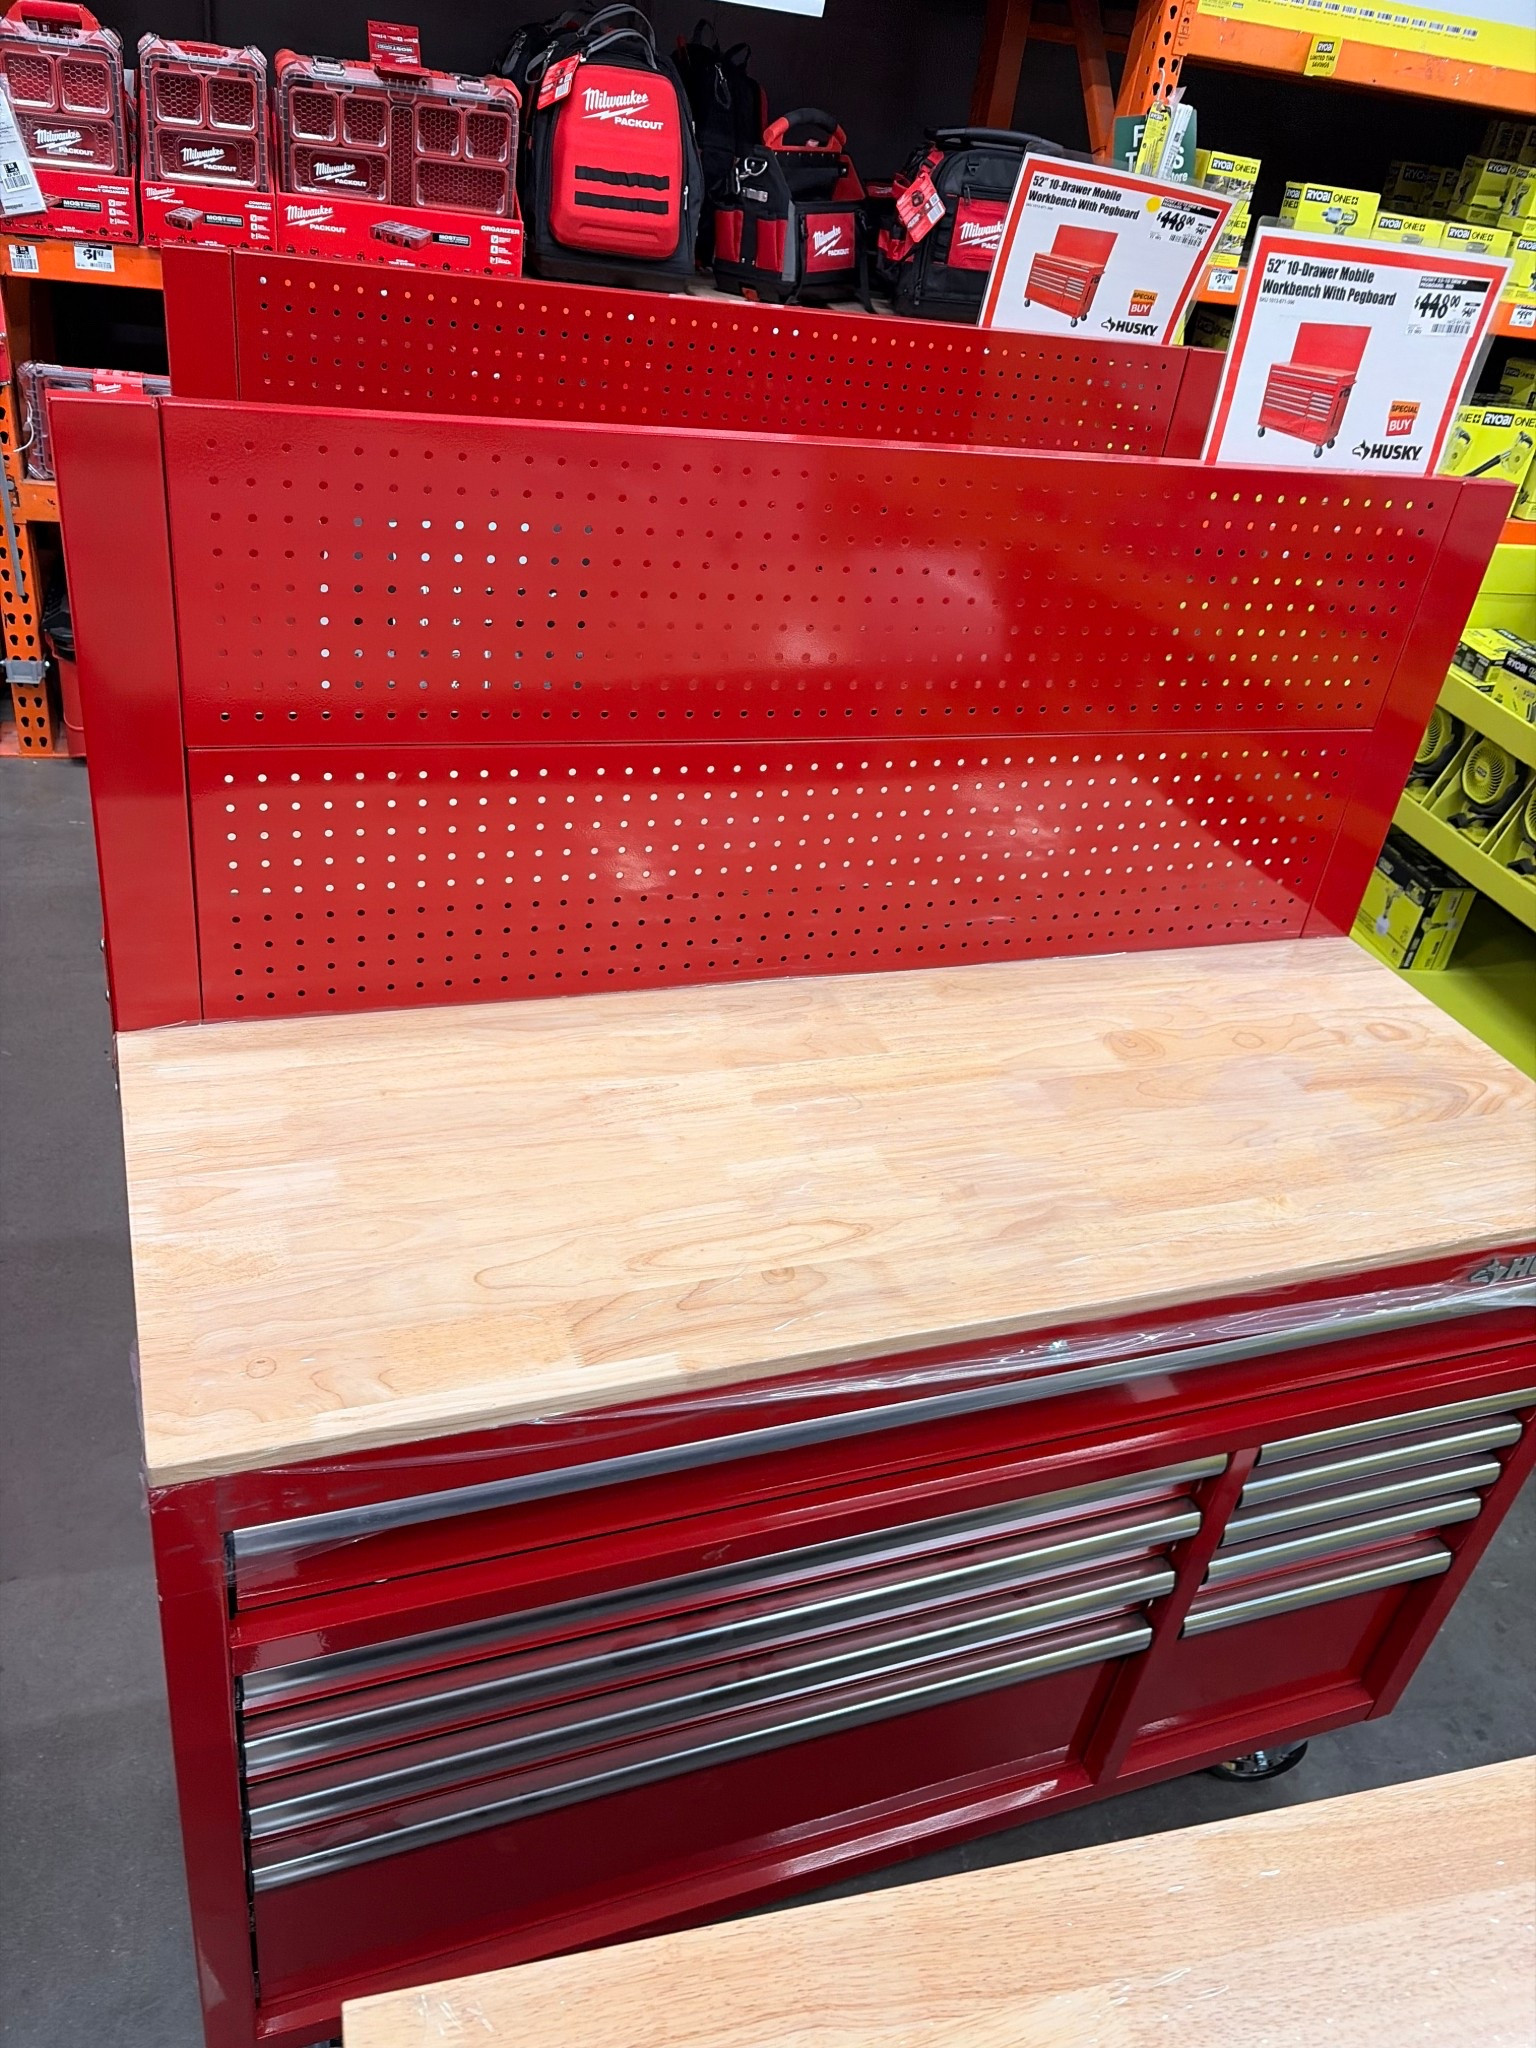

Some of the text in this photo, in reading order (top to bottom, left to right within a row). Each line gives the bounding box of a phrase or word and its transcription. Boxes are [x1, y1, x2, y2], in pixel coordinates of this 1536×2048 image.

[581, 87, 648, 111] Milwaukee
[614, 116, 664, 131] PACKOUT
[33, 129, 81, 143] Milwaukee
[59, 147, 94, 156] PACKOUT
[180, 147, 224, 162] Milwaukee
[203, 164, 237, 172] PACKOUT
[313, 162, 355, 176] Milwaukee
[1212, 159, 1234, 171] RYOBI
[334, 178, 367, 187] PACKOUT
[1033, 175, 1122, 202] 52" 10-Drawer Mobile
[145, 187, 175, 198] Milwaukee
[1286, 189, 1300, 198] RYOBI
[1305, 188, 1331, 202] RYOBI
[1028, 189, 1077, 208] Workbench
[1078, 198, 1098, 213] With
[1098, 203, 1140, 220] Pegboard
[284, 205, 333, 221] Milwaukee
[310, 223, 347, 233] PACKOUT
[480, 225, 520, 235] ORGANIZER
[1379, 217, 1401, 229] RYOBI
[813, 225, 841, 250] Milwaukee
[960, 221, 1004, 240] Milwauk
[1448, 227, 1470, 239] RYOBI
[1518, 240, 1536, 250] RYOB
[1267, 258, 1374, 283] 52" 10-Drawer Mobile
[1132, 292, 1157, 301] SPECIAL
[1262, 279, 1397, 306] Workbench With Pegboard
[1131, 303, 1150, 314] BUY
[1116, 320, 1158, 336] HUSKY
[1391, 404, 1418, 414] SPECIAL
[1389, 419, 1411, 432] BUY
[1483, 412, 1513, 426] RYOBI
[1370, 443, 1423, 461] HUSKY
[1506, 656, 1528, 674] RYOBI
